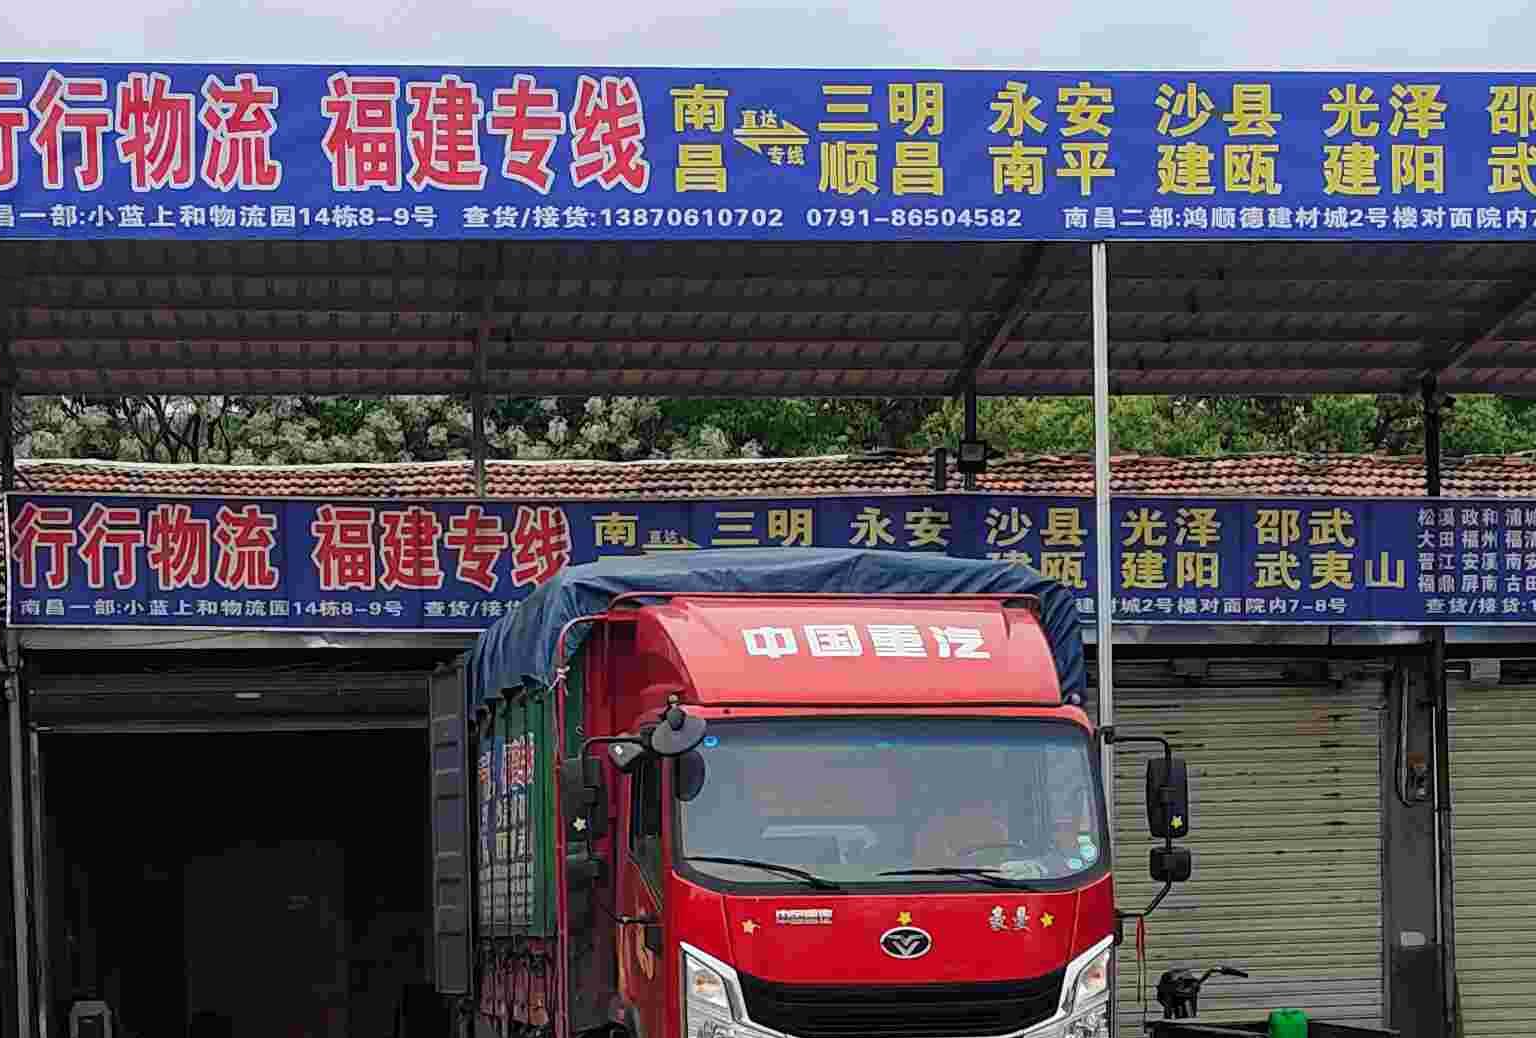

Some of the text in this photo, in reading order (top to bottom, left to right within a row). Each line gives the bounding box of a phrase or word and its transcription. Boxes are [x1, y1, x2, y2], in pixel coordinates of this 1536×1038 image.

[739, 108, 778, 129] 直达
[817, 81, 944, 136] 三明
[989, 80, 1116, 137] 永安
[1154, 82, 1282, 138] 沙县
[1321, 83, 1448, 138] 光泽
[321, 74, 649, 193] 福建专线
[766, 145, 806, 167] 专线
[818, 141, 944, 196] 顺昌
[989, 142, 1116, 196] 南平
[1156, 142, 1282, 196] 建瓯
[1321, 143, 1448, 197] 建阳
[806, 208, 1024, 229] 0791-86504582
[13, 501, 571, 593] 行行物流 福建专线
[711, 507, 1356, 548] 三明 永安 沙县 光泽 邵武
[1120, 551, 1220, 590] 建阳
[1253, 551, 1406, 591] 武夷山
[741, 624, 991, 661] 中国重汽
